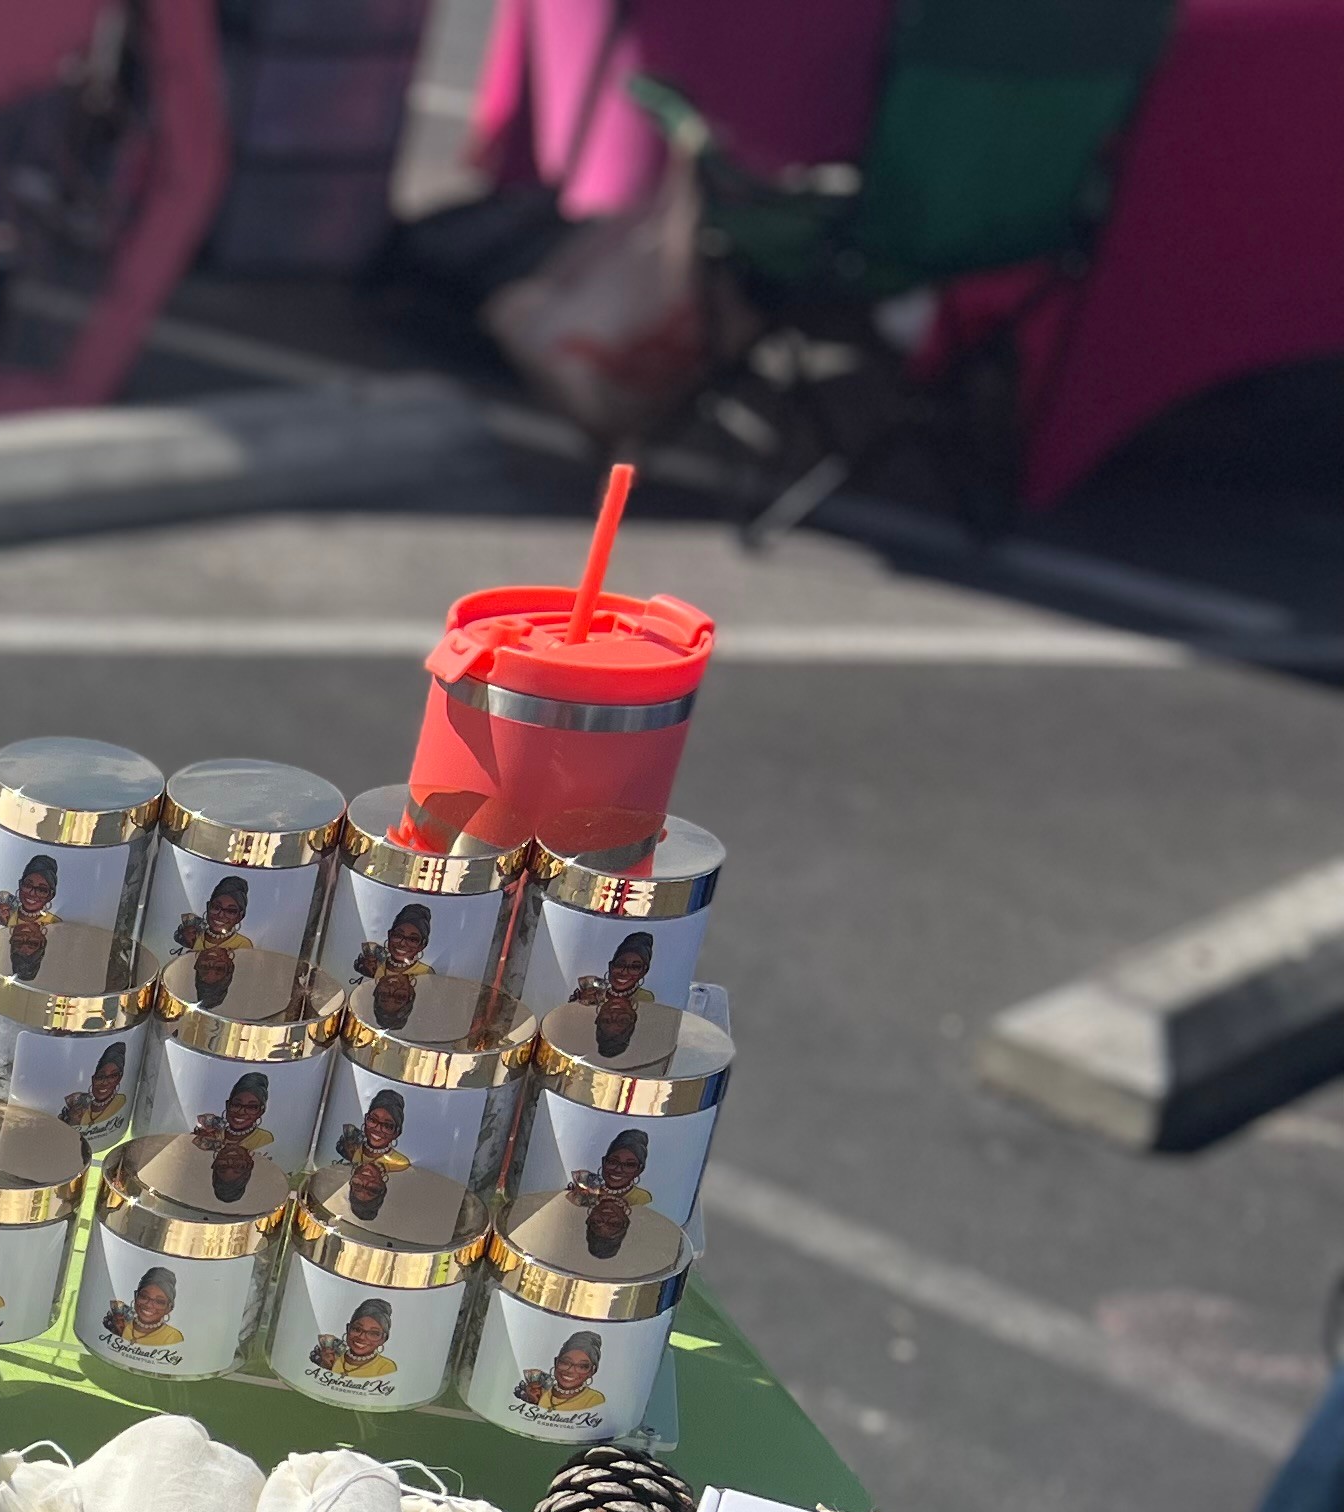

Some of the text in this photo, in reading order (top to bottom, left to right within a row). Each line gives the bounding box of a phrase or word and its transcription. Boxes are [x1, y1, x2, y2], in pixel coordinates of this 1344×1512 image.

[98, 1333, 183, 1366] A Spiritual Key
[304, 1367, 396, 1397] A Spiritual Key
[508, 1403, 603, 1429] A Spiritual Key
